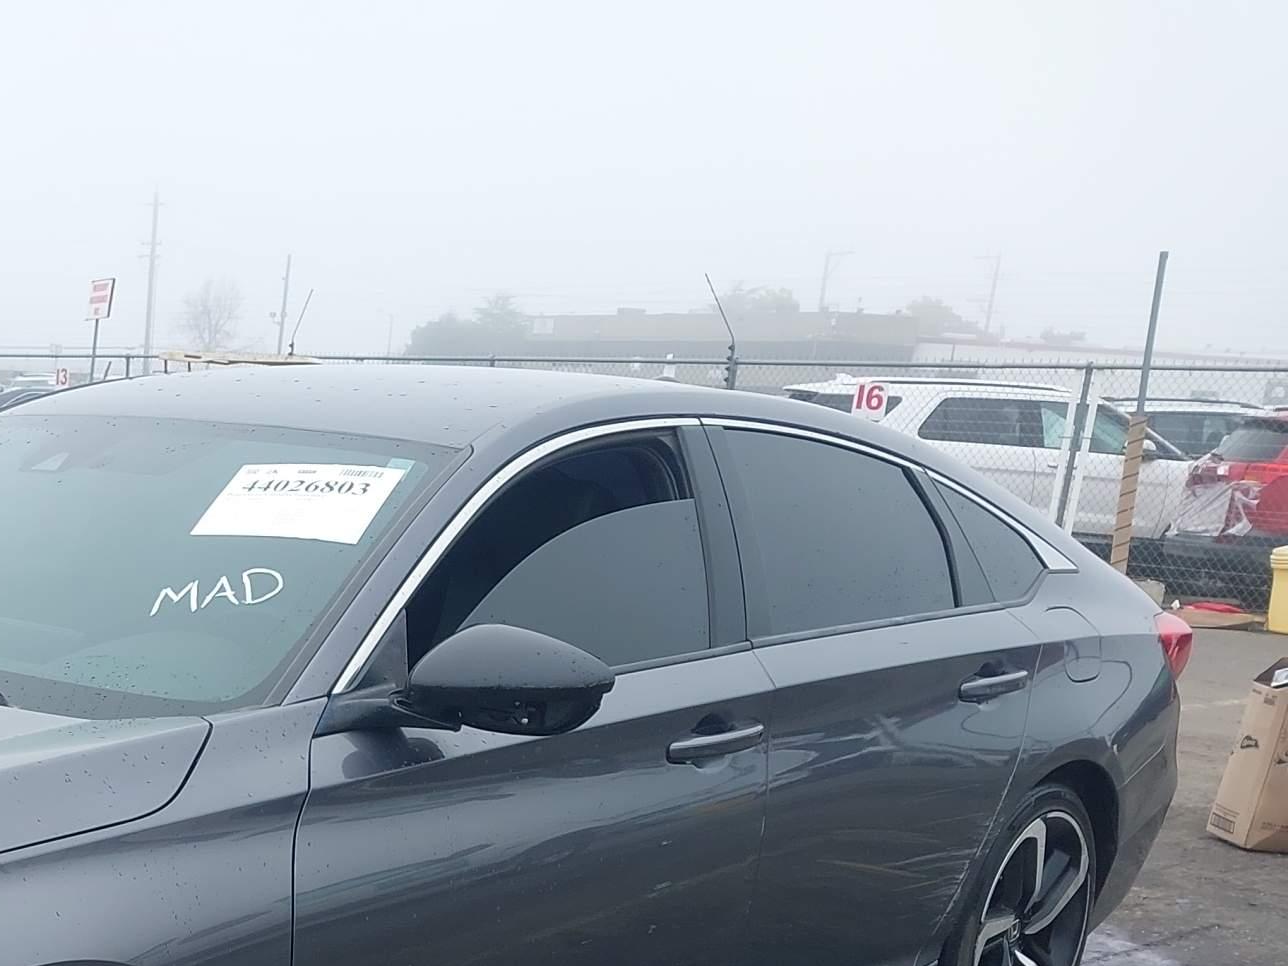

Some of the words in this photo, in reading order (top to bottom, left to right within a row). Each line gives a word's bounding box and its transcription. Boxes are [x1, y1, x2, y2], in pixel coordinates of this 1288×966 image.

[55, 368, 68, 385] 13
[855, 384, 884, 410] 16
[242, 479, 371, 496] 44026803
[149, 567, 284, 616] MAD
